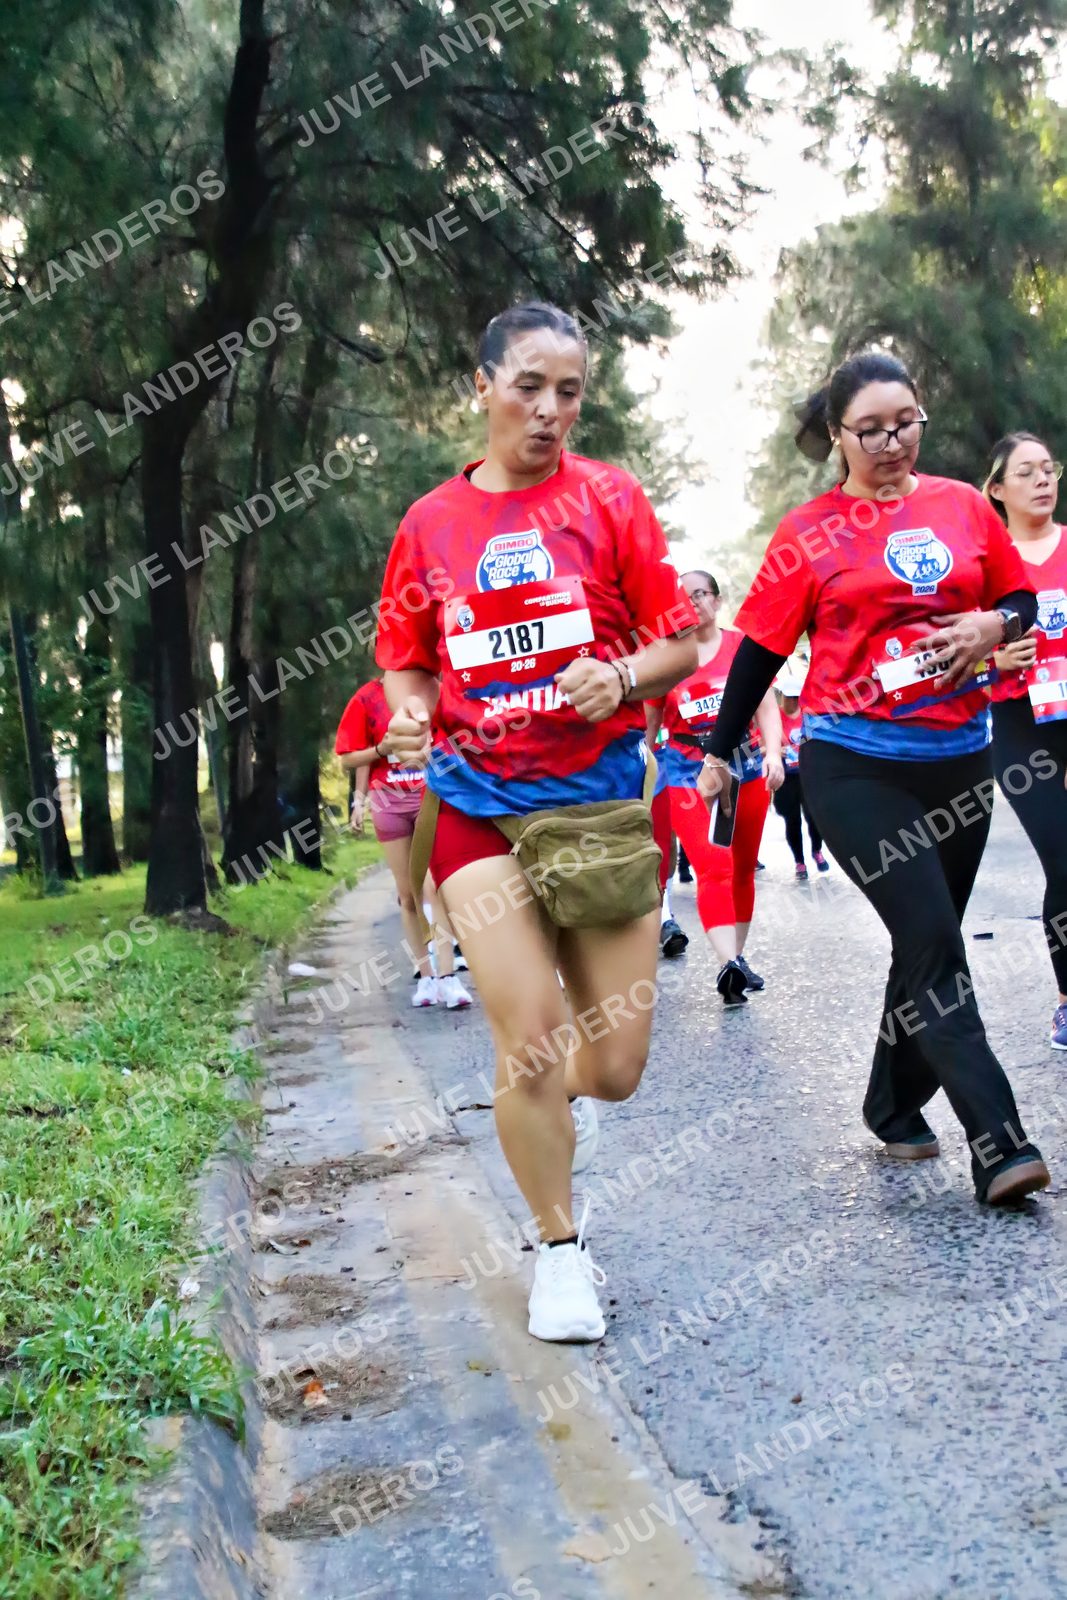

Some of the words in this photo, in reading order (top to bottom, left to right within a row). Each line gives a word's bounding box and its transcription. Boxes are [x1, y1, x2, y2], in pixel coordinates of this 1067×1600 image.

[494, 538, 533, 551] BIMBO
[495, 549, 533, 568] Global
[488, 566, 520, 581] Race
[915, 584, 936, 594] 2026
[488, 620, 544, 659] 2187
